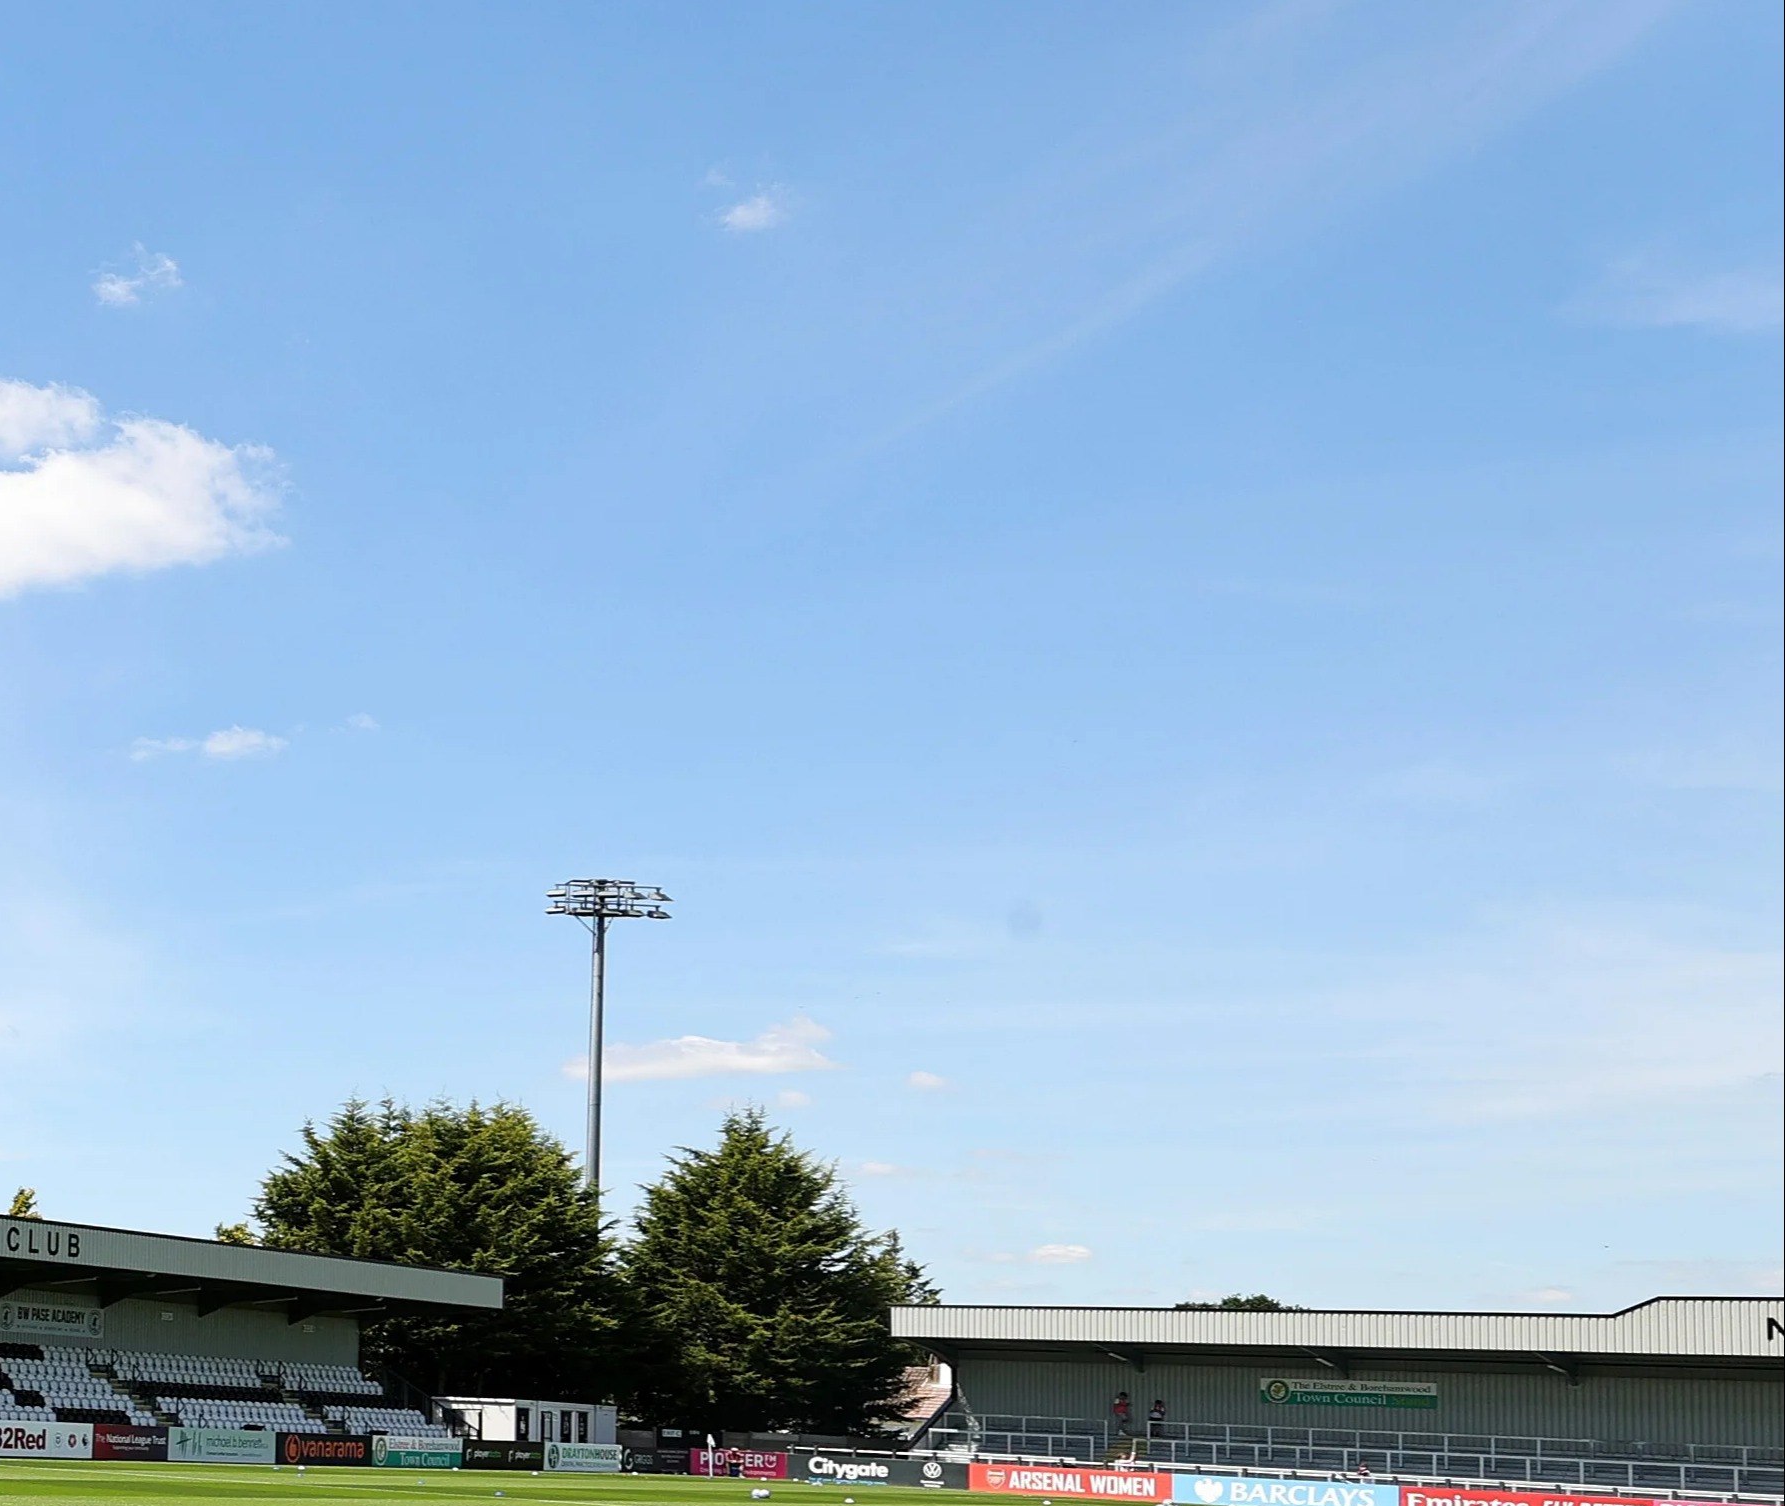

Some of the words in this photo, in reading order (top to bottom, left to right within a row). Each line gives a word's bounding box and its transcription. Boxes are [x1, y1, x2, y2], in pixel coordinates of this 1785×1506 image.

[6, 1226, 81, 1258] CLUB
[51, 1308, 86, 1324] ACADEMY
[1292, 1381, 1310, 1390] The
[1312, 1382, 1345, 1391] Elstree
[1347, 1383, 1358, 1391] &
[1360, 1383, 1431, 1393] Borehamwood
[1293, 1392, 1330, 1403] Town
[1334, 1393, 1387, 1406] Council
[106, 1433, 131, 1443] National
[132, 1434, 152, 1446] League
[152, 1435, 167, 1445] Trust
[301, 1441, 365, 1459] vanarama
[400, 1452, 421, 1466] Town
[421, 1453, 451, 1466] Council
[808, 1456, 890, 1479] Citygate
[1009, 1470, 1087, 1493] ARSENAL
[1090, 1475, 1156, 1497] WOMEN
